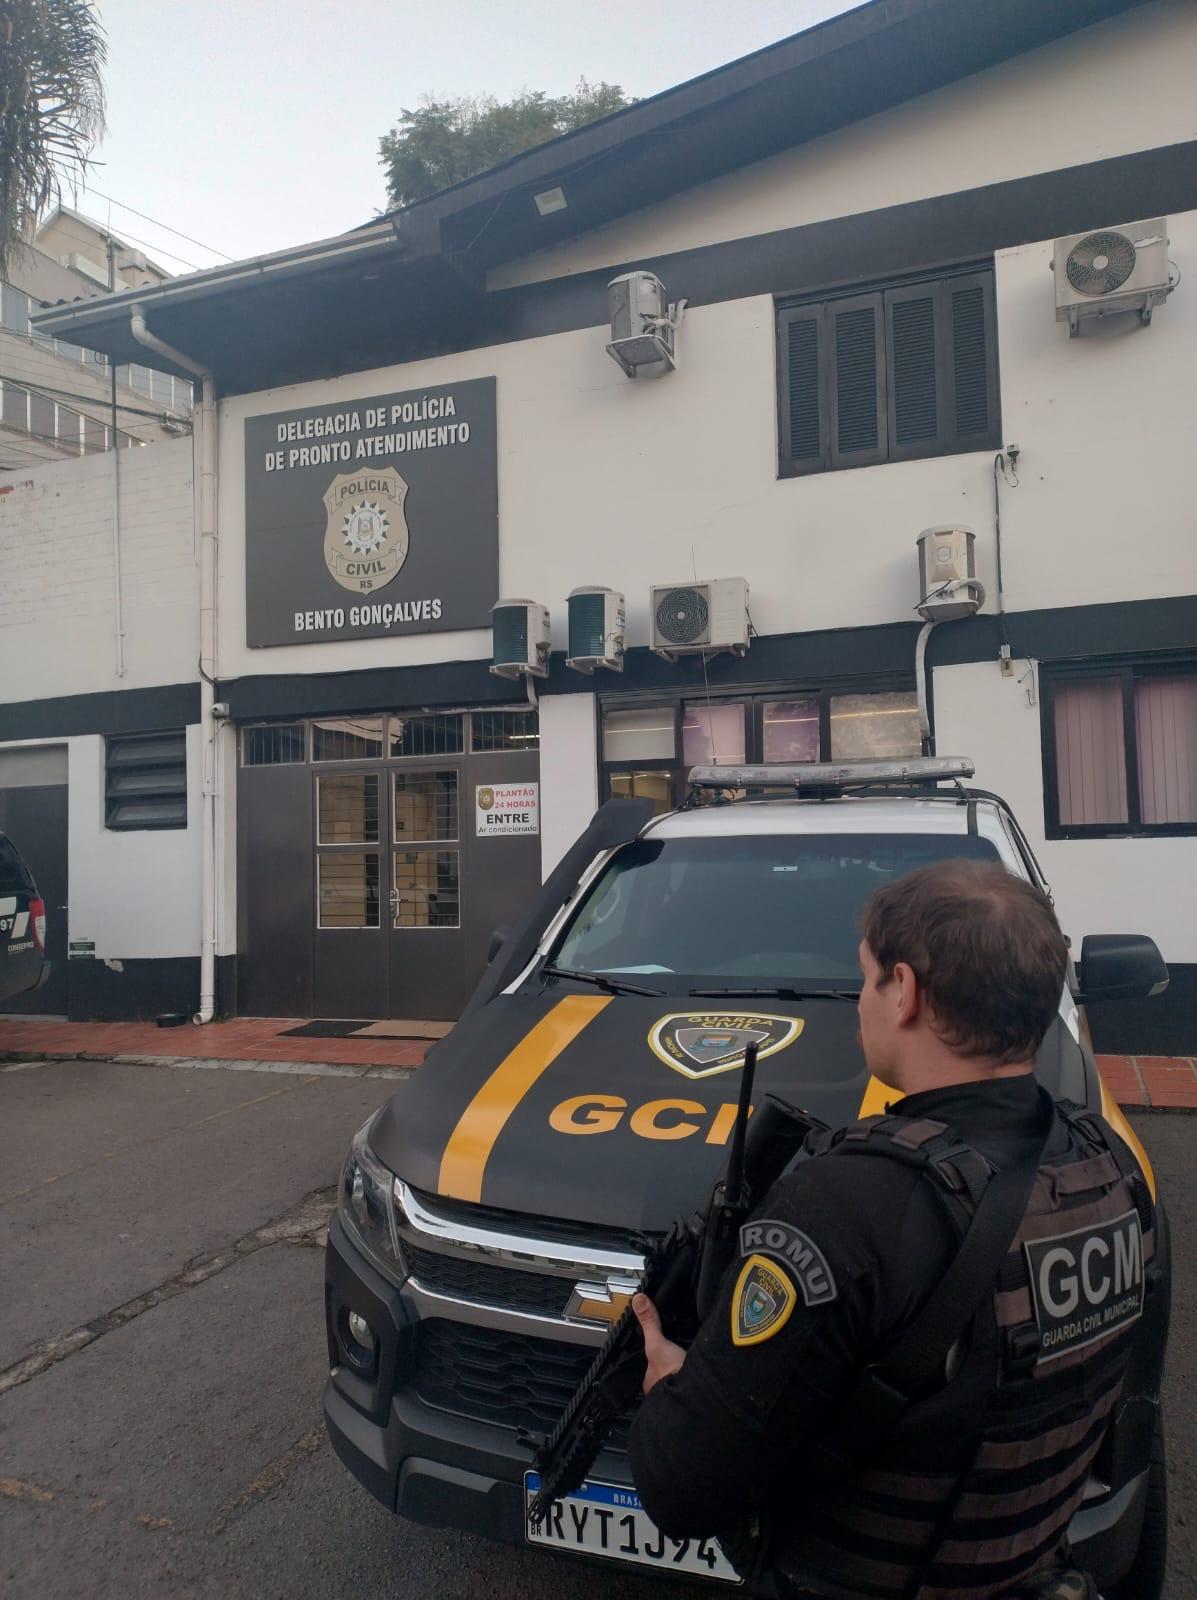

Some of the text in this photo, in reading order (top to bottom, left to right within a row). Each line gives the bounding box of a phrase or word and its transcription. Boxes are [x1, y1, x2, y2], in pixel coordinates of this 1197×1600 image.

[277, 396, 456, 442] DELEGACIA DE POLÍCIA
[265, 423, 470, 471] DE PRONTO ATENDIMENTO
[340, 477, 390, 498] POLÍCIA
[346, 560, 386, 575] CIVIL
[360, 579, 373, 589] RS
[294, 598, 442, 631] BENTO GONÇALVES
[495, 789, 535, 797] PLANTÃO
[506, 800, 536, 808] HORAS
[486, 813, 530, 824] ENTRE
[488, 825, 537, 833] condicionado
[688, 1016, 773, 1026] GUARDA
[701, 1021, 753, 1030] CIVIL
[745, 1226, 829, 1295] ROMU
[1039, 1222, 1141, 1318] GCM
[757, 1268, 782, 1297] GUARDA
[759, 1279, 776, 1297] CIVIL
[1042, 1294, 1140, 1348] GUARDA CIVIL MUNICIPAL
[613, 1492, 642, 1508] BRAS
[530, 1523, 542, 1536] BR
